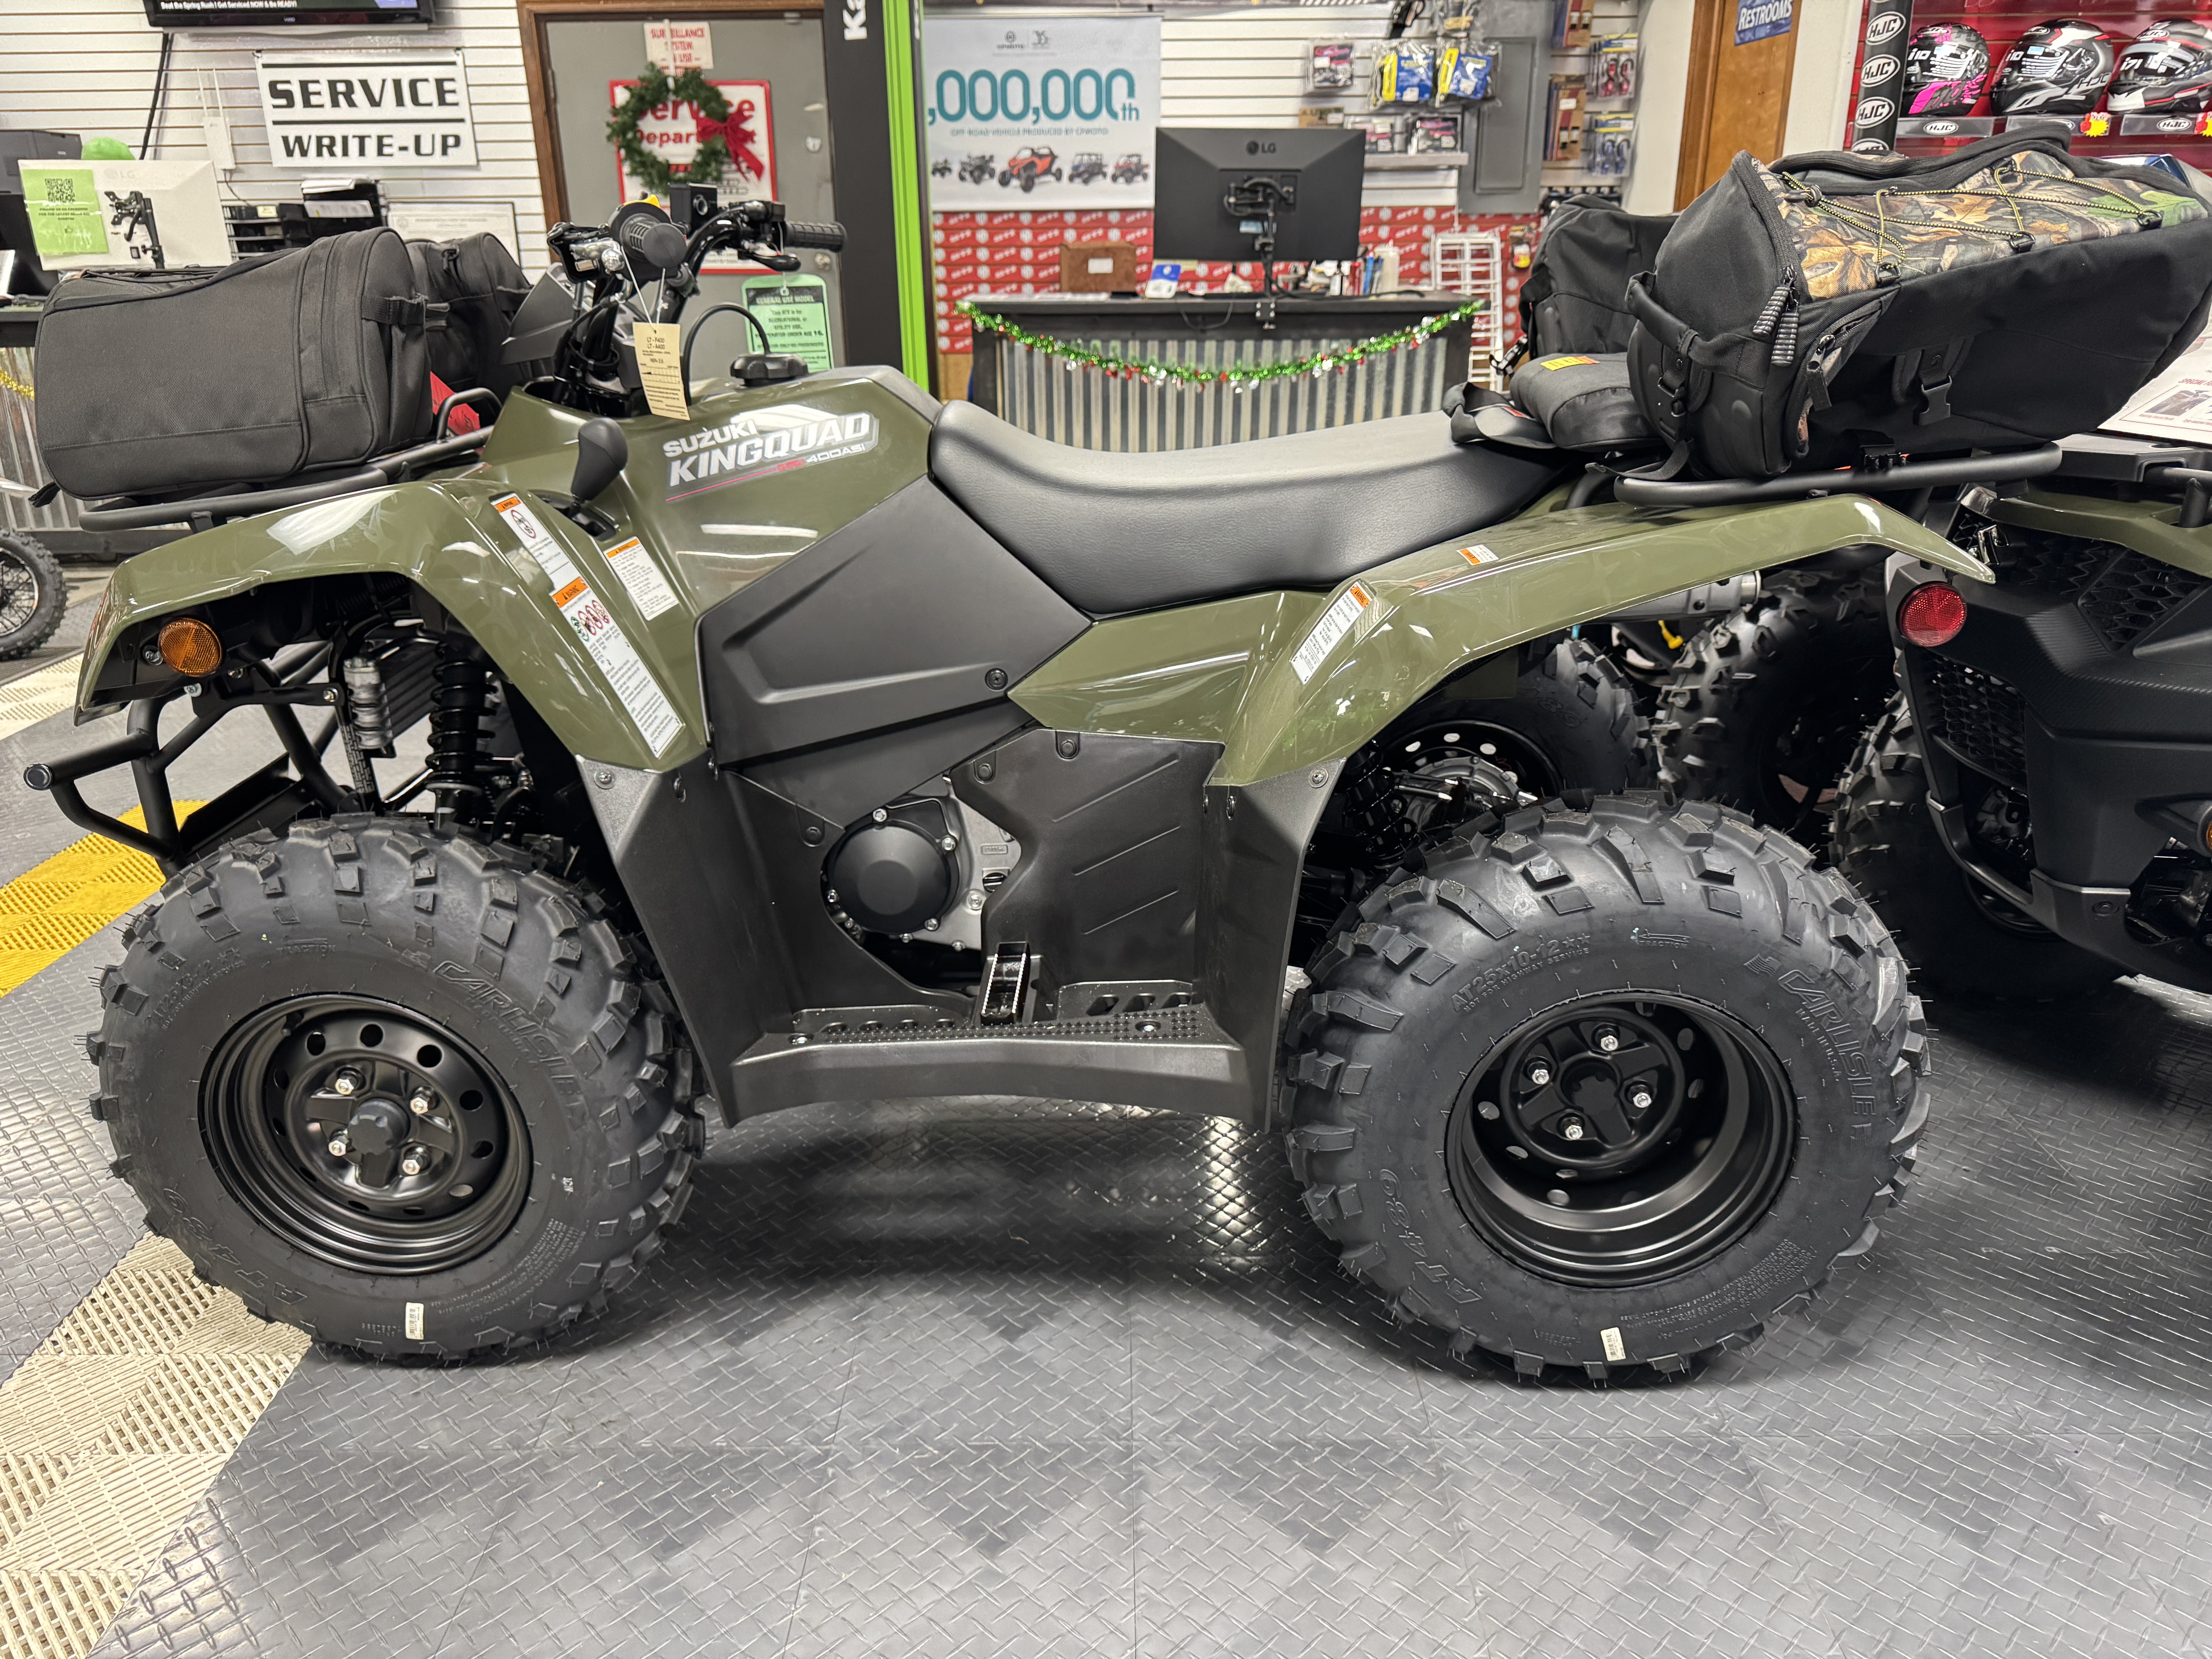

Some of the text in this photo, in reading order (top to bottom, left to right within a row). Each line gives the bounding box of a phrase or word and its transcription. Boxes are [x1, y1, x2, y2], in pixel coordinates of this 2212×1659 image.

[1738, 1, 1792, 31] RESTROOMS
[1869, 17, 1899, 39] HJC
[1863, 59, 1894, 80] HJC
[2076, 72, 2111, 89] HJC
[268, 77, 460, 109] SERVICE
[1858, 101, 1889, 121] HJC
[282, 134, 461, 158] WRITE-UP
[663, 420, 758, 457] SUZUKI
[670, 413, 871, 487] KINGQUAD
[1463, 945, 1589, 1013] NOT FOR HIGHWAY SERVICE
[1778, 969, 1876, 1116] CARLISLE
